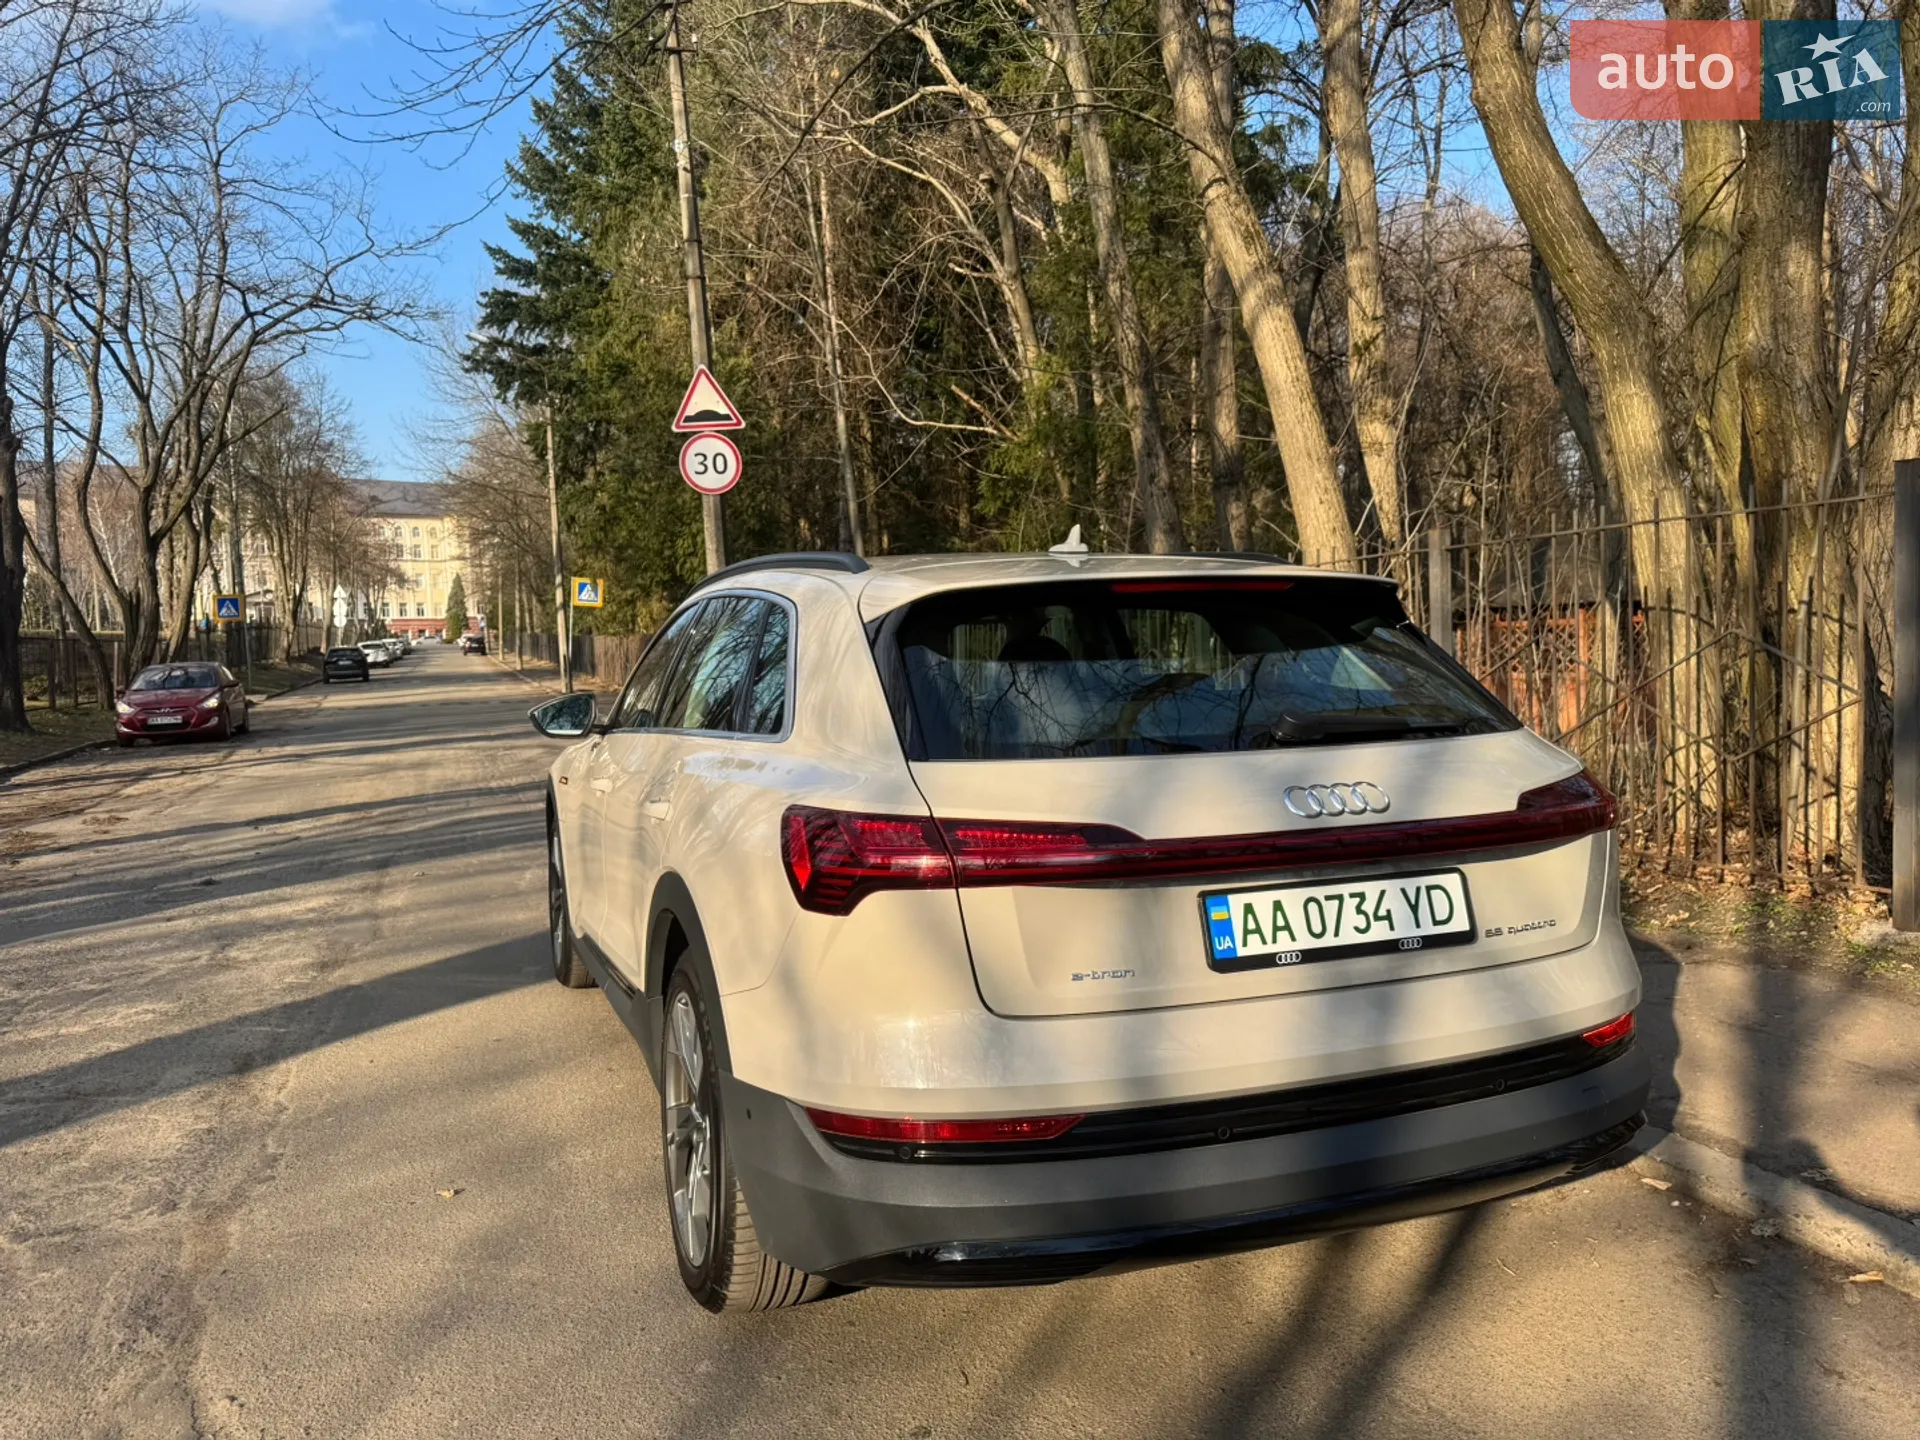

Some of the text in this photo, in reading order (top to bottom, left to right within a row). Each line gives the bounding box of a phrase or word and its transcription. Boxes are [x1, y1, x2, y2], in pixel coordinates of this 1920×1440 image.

[693, 452, 728, 475] 30
[1241, 884, 1454, 948] AA 0734 YD
[1214, 935, 1234, 950] UA
